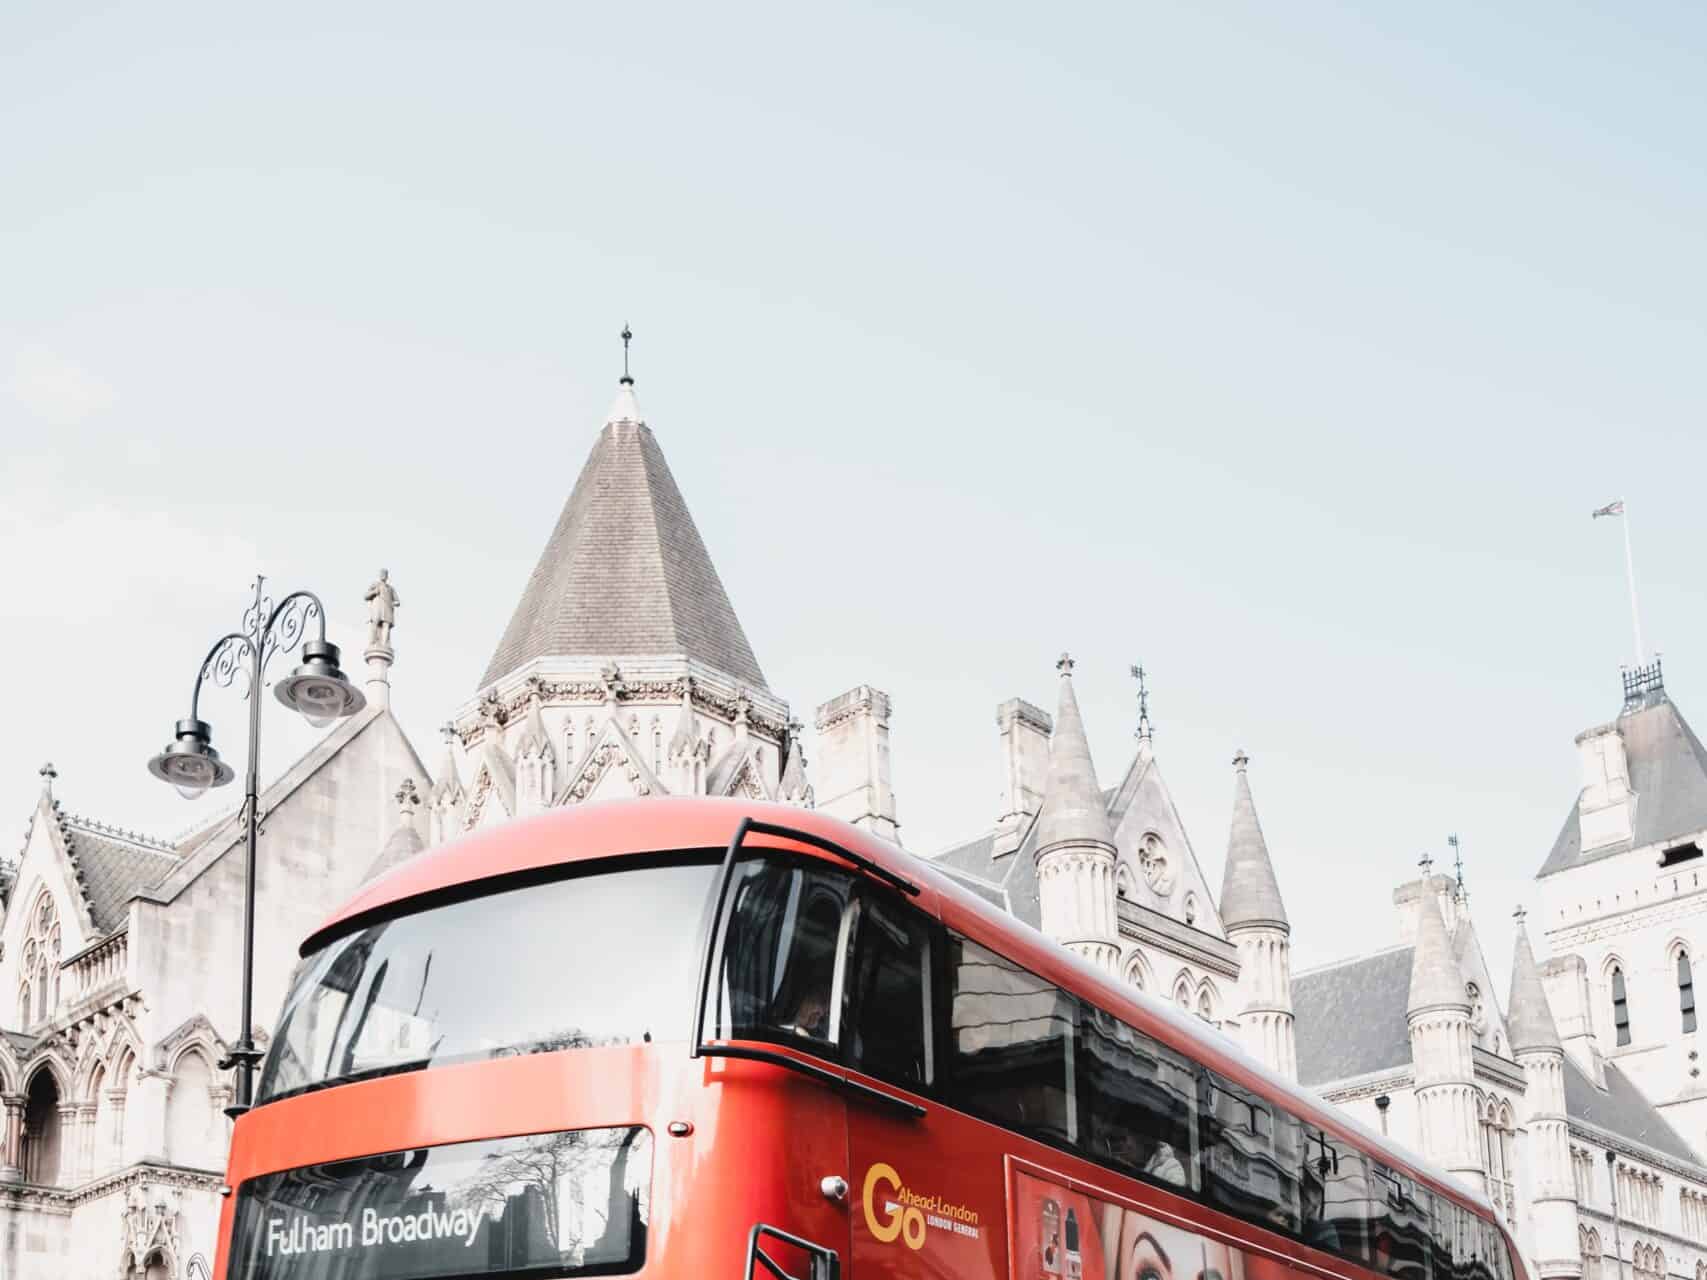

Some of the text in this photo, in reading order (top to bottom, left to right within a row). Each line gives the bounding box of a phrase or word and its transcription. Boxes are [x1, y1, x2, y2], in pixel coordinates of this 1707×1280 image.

[267, 1200, 486, 1257] Fulham Broadway
[863, 1163, 926, 1250] Go
